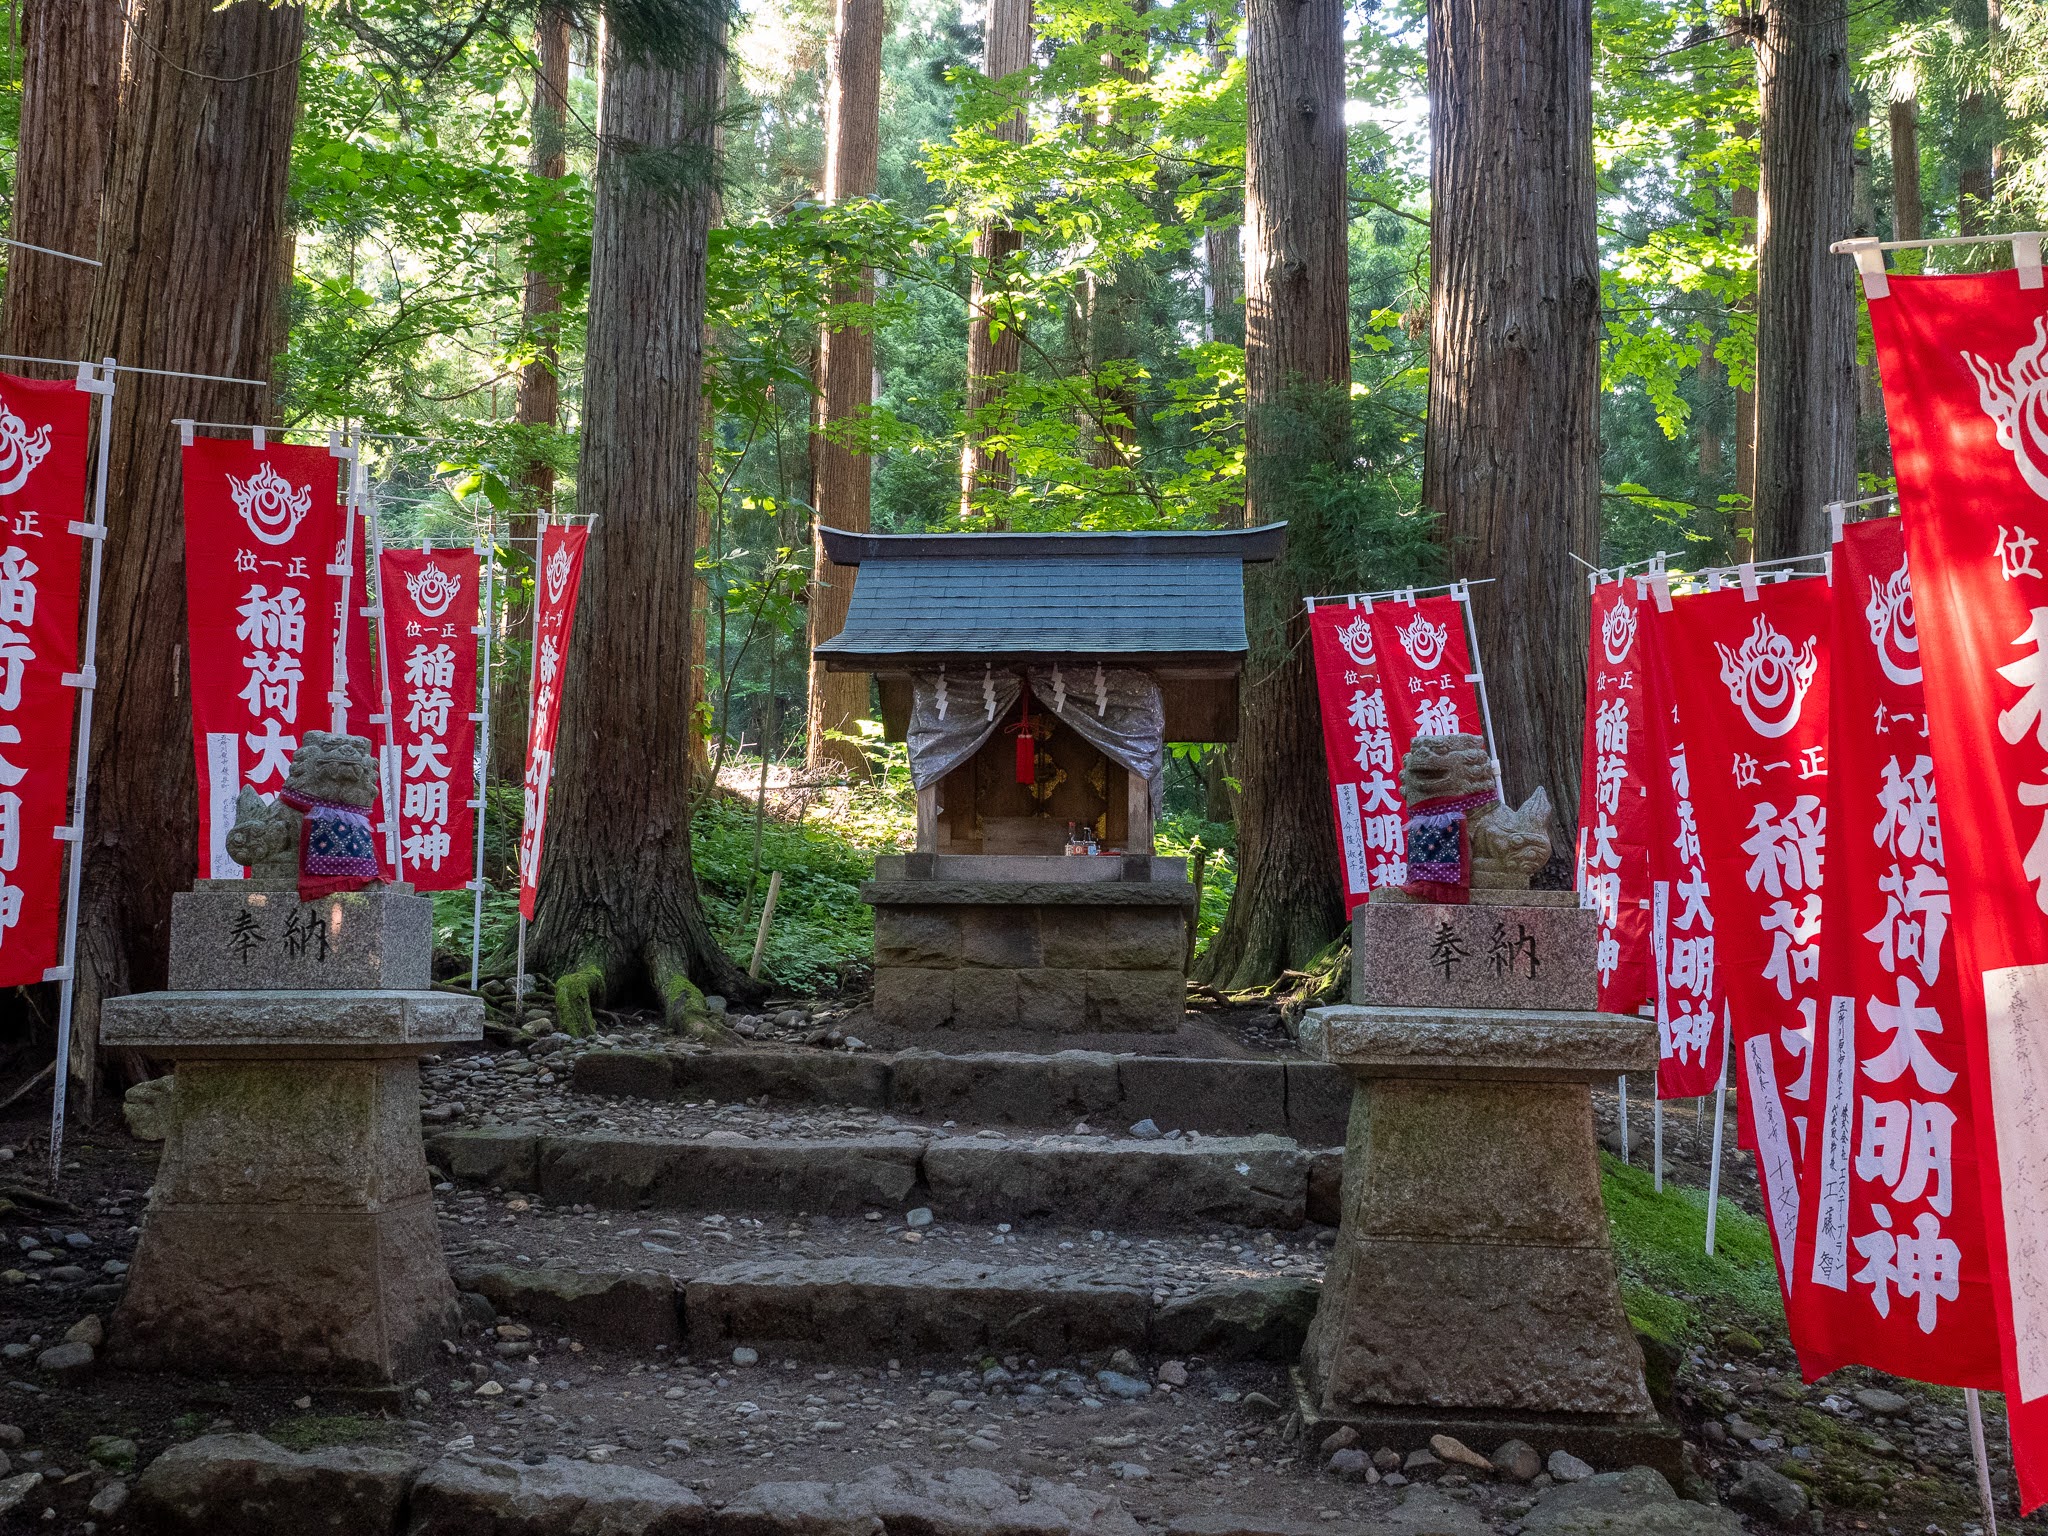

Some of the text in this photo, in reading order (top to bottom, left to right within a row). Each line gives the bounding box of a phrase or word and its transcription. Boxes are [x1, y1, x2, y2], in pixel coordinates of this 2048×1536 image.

[235, 584, 306, 806] 稲荷大
[402, 644, 456, 872] 稲荷大明神
[1347, 689, 1409, 887] 稲荷大明神
[227, 907, 332, 964] 奉納
[1427, 921, 1541, 980] 奉納
[1852, 754, 1962, 1334] 稲荷大明神
